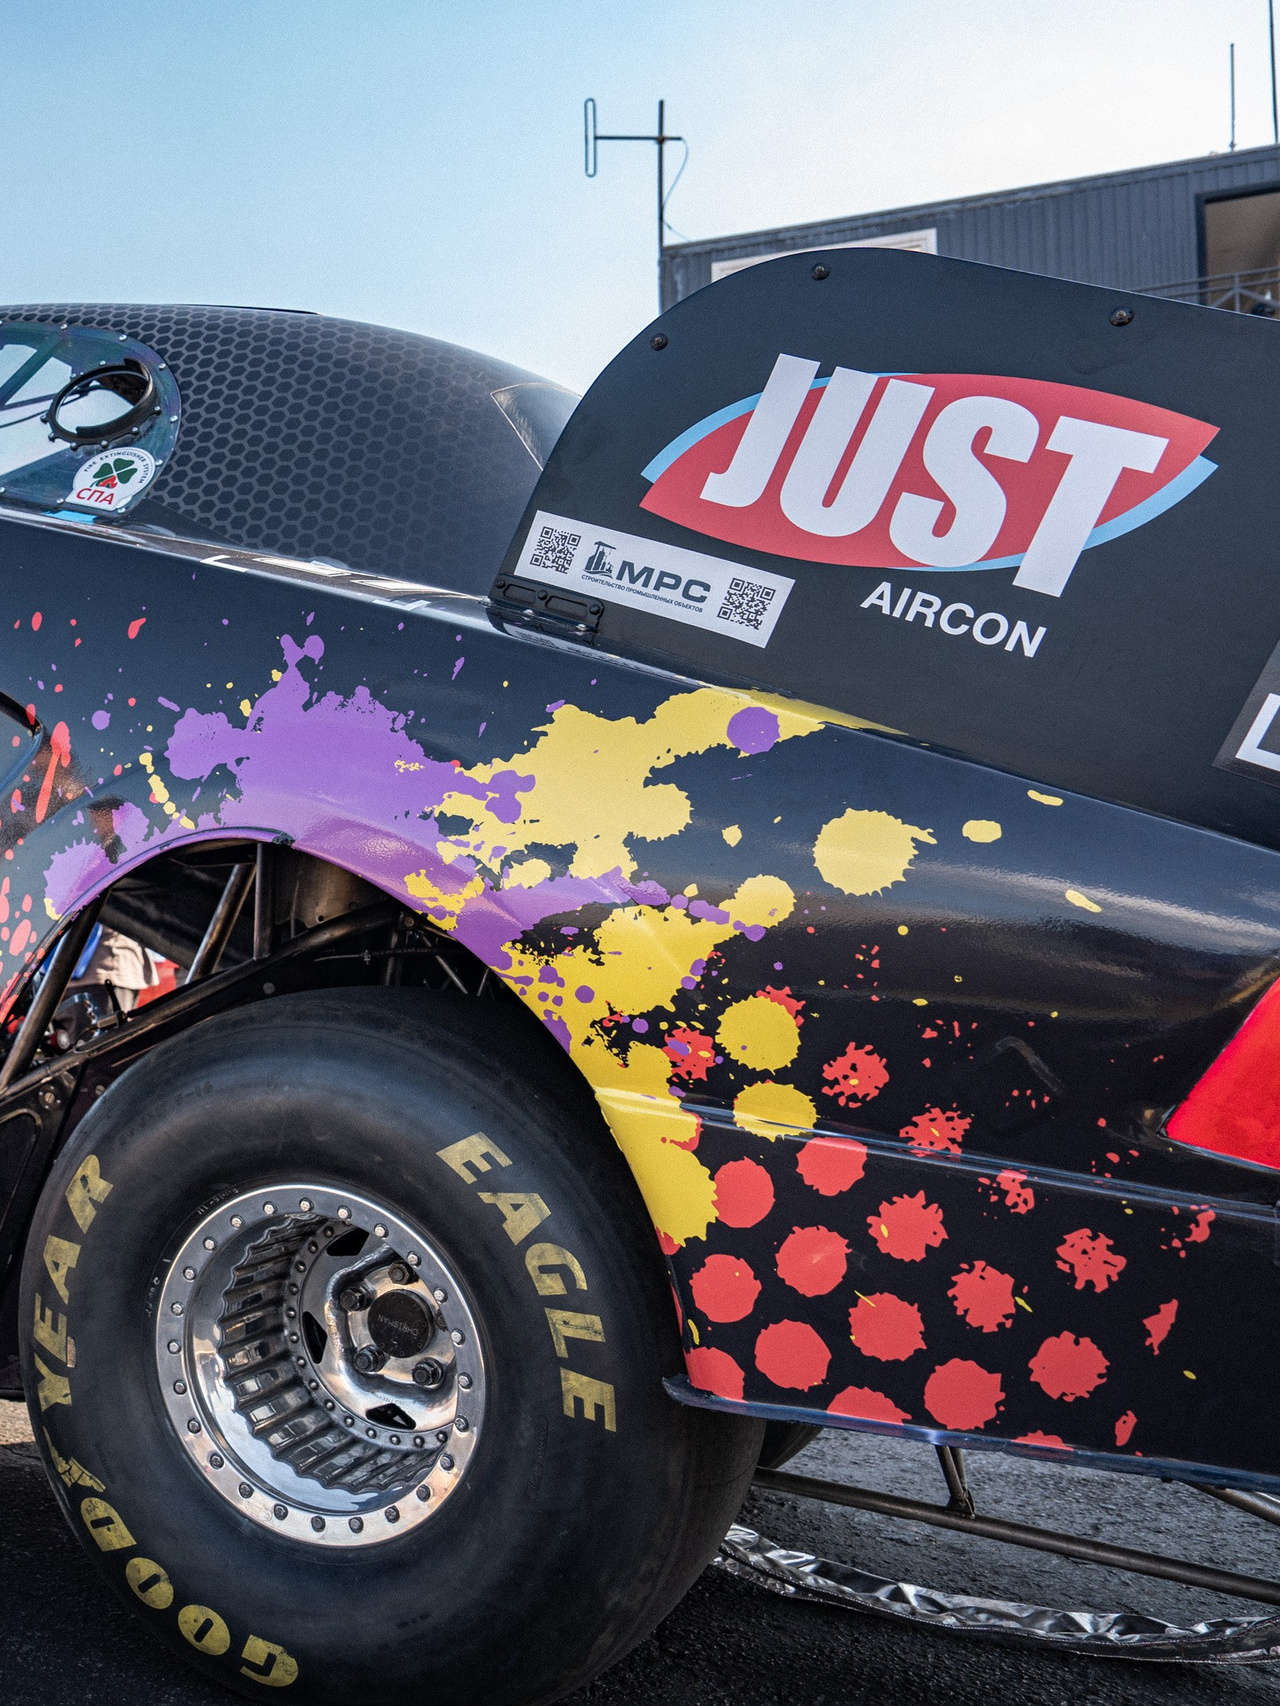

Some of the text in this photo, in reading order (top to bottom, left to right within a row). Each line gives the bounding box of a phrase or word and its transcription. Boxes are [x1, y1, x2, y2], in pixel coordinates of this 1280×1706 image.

[83, 451, 150, 484] FIRE EXTINGUISHER SYSTEM
[699, 353, 1170, 597] JUST
[76, 488, 114, 505] СПА
[581, 574, 703, 613] СТРОИТЕЛЬСТВО ПРОМЫШЛЕННЫХ ОБЪЕКТОВ
[860, 581, 1047, 658] AIRCON
[436, 1131, 617, 1432] EAGLE
[377, 1314, 419, 1336] CHRISMAN
